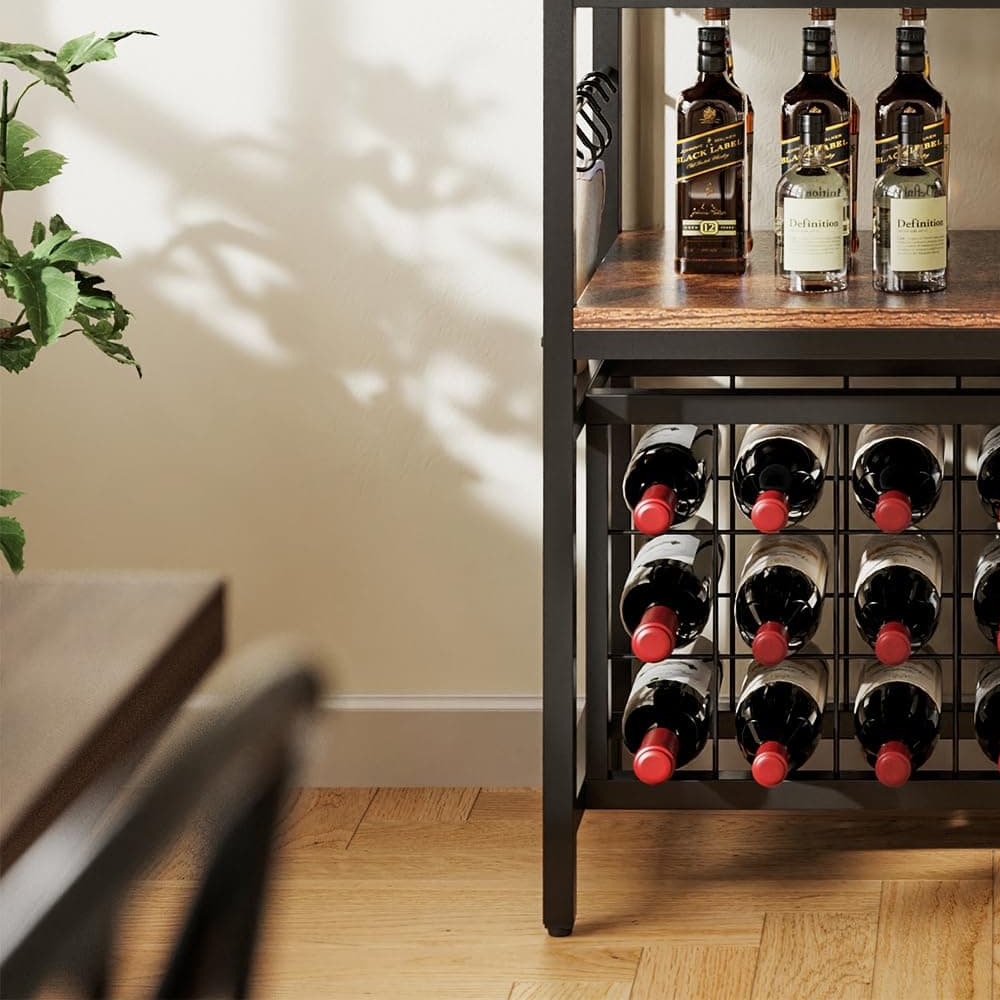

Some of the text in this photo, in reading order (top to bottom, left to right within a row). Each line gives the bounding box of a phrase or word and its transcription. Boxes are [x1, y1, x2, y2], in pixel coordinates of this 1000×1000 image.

[676, 149, 708, 164] BLACK
[710, 138, 743, 154] LABEL
[703, 222, 716, 232] 12
[789, 217, 839, 228] Definition
[897, 217, 944, 228] Definition
